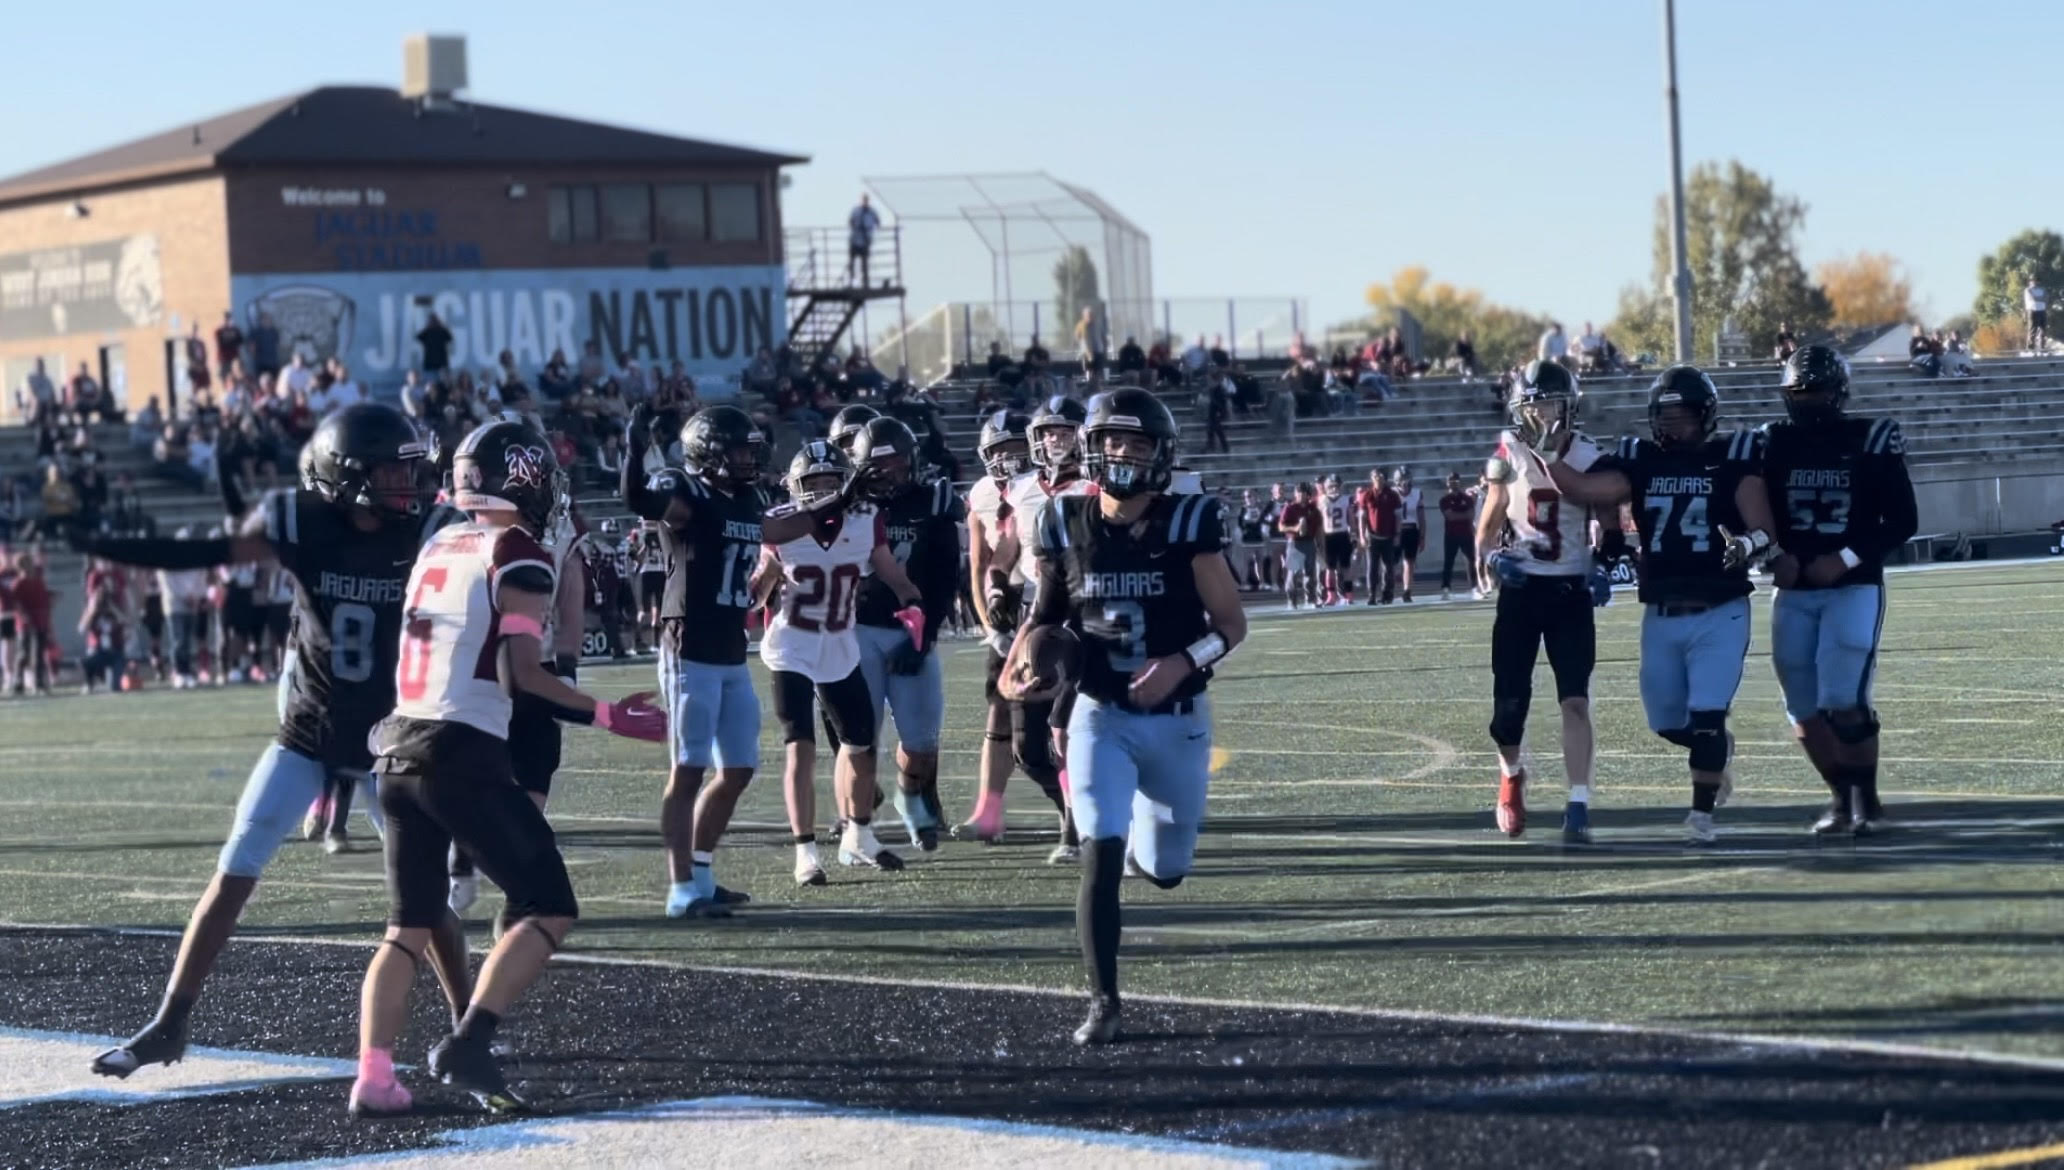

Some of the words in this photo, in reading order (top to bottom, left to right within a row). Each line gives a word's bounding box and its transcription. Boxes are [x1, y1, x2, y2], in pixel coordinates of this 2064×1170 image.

[281, 186, 361, 206] Welcome
[366, 187, 386, 206] to
[589, 285, 773, 364] NATION
[1645, 477, 1713, 494] JAGUARS
[1785, 469, 1851, 489] JAGUARS
[1527, 488, 1562, 561] 9
[1644, 496, 1710, 552] 74
[1787, 490, 1852, 533] 53
[313, 571, 402, 602] JAGUARS
[716, 542, 760, 608] 13
[787, 563, 860, 635] 20
[1079, 572, 1165, 598] JAGUARS
[331, 602, 376, 682] 8
[400, 567, 448, 700] 6
[581, 631, 607, 654] 30
[1102, 600, 1149, 672] 3
